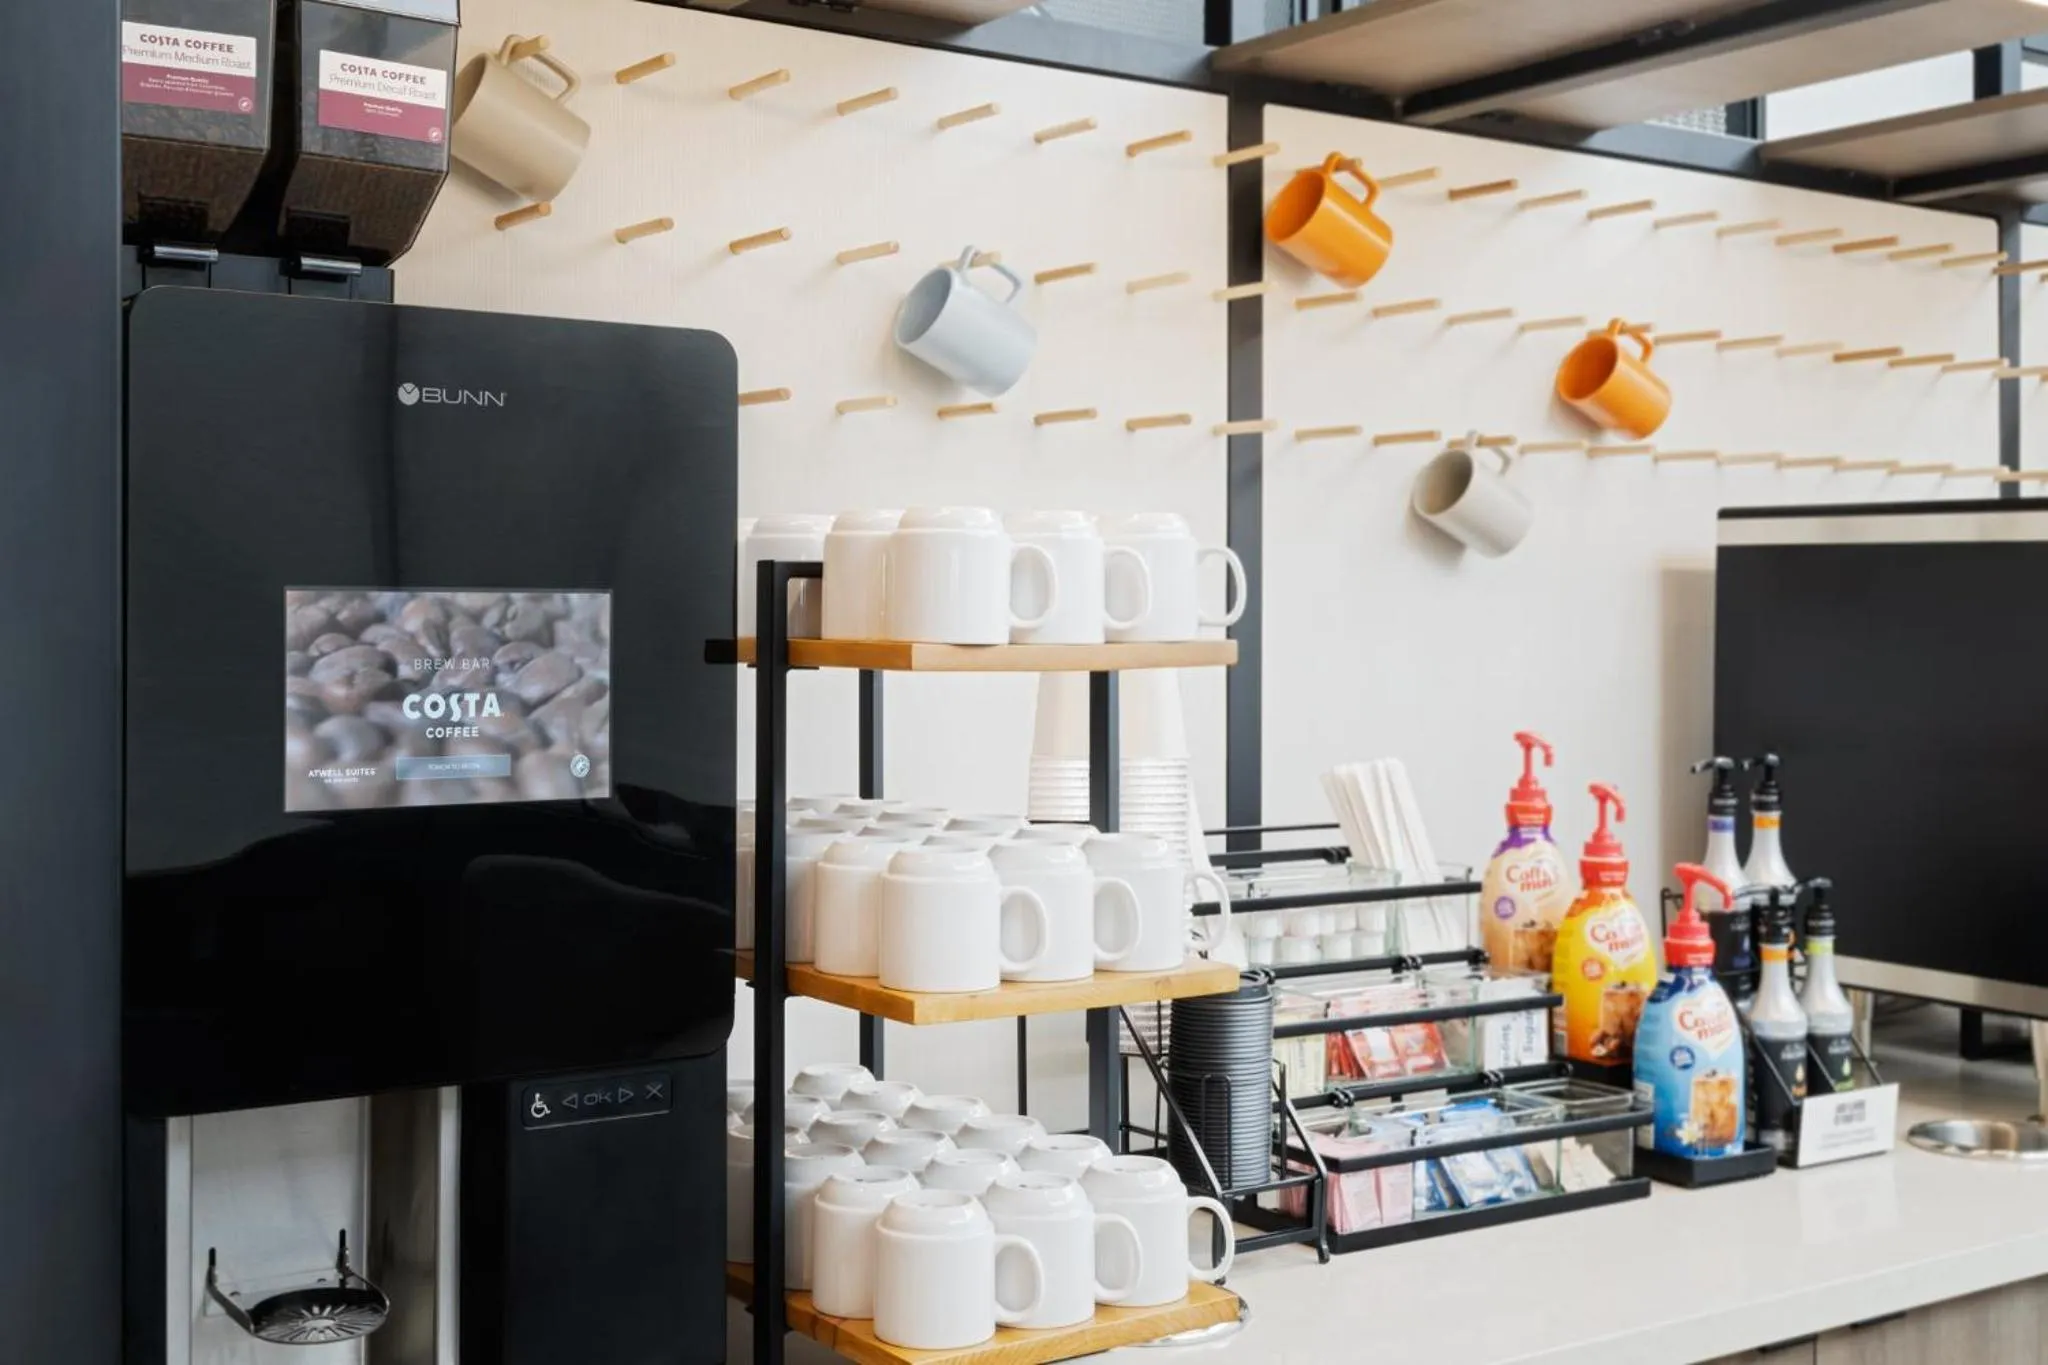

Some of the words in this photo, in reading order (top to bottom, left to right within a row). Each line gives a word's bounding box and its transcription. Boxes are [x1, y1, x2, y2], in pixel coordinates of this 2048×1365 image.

[139, 33, 180, 47] COSTA
[184, 39, 235, 54] COFFEE
[122, 44, 173, 61] Premium
[174, 51, 220, 66] Medium
[221, 56, 252, 70] Roast
[329, 72, 375, 90] Premium
[340, 63, 377, 77] COSTA
[381, 70, 427, 85] COFFEE
[421, 386, 504, 408] BUNN
[414, 656, 456, 671] BREW
[462, 656, 491, 671] BAR
[402, 691, 502, 723] COSTA
[425, 726, 480, 738] COFFEE
[308, 768, 344, 778] ATWELL
[345, 767, 376, 777] SUITES
